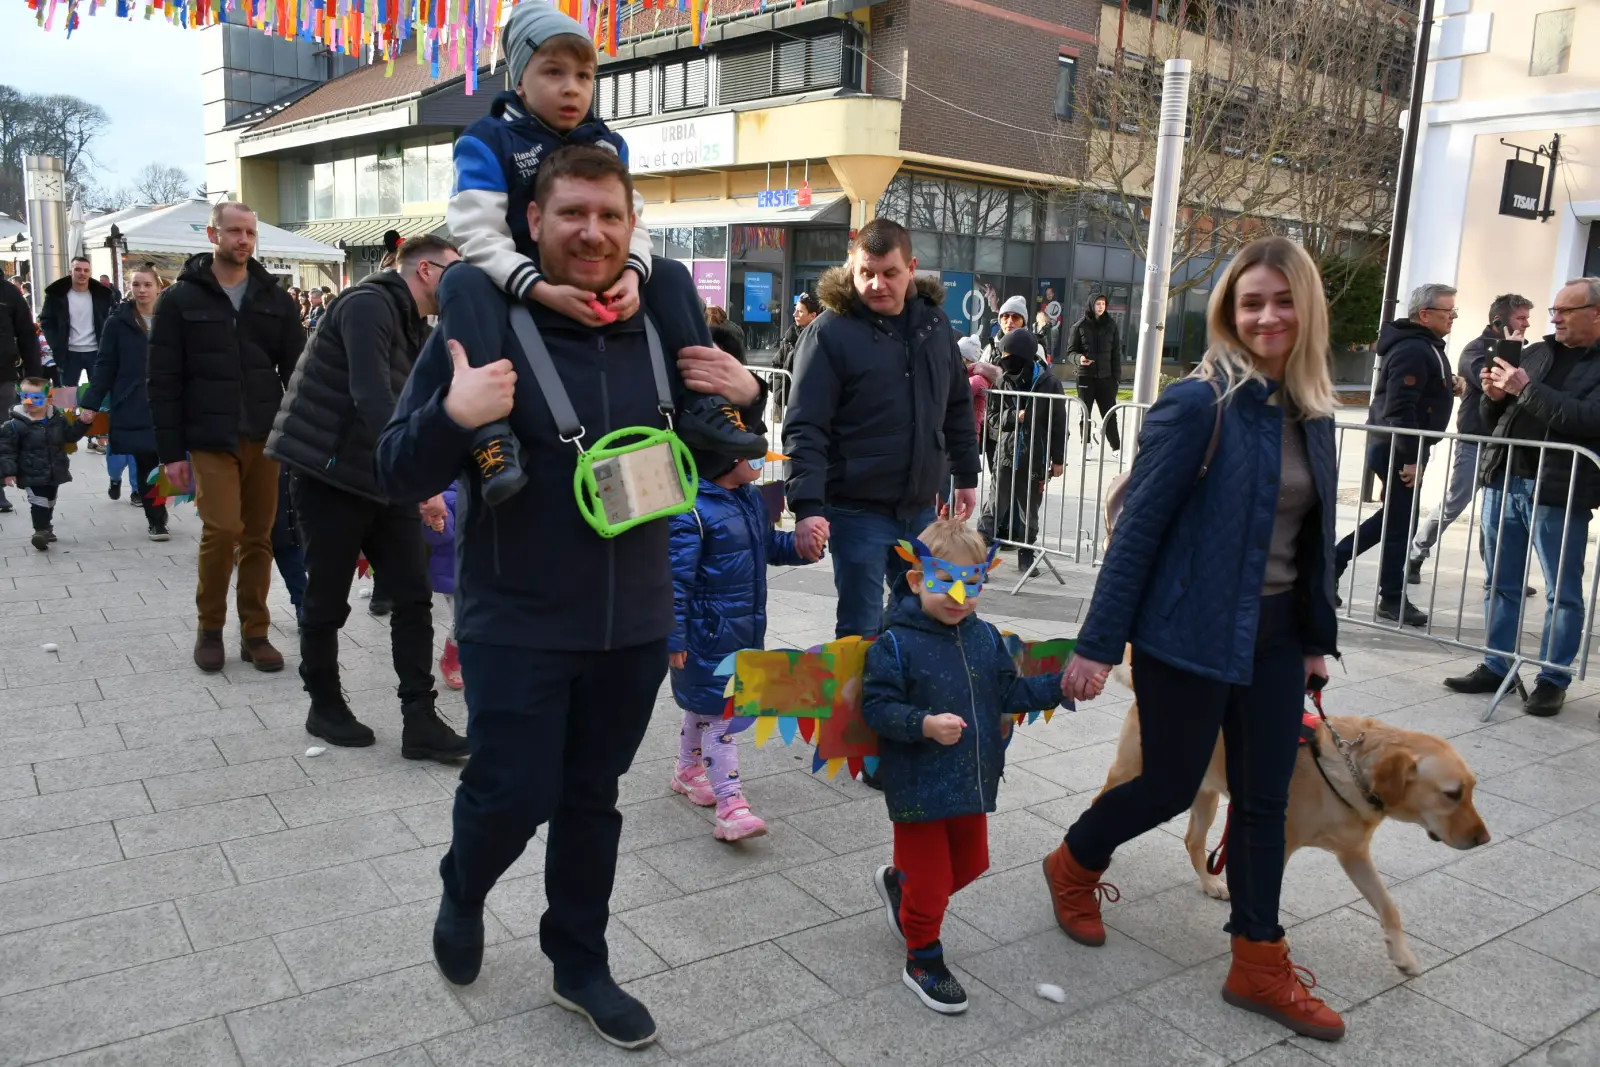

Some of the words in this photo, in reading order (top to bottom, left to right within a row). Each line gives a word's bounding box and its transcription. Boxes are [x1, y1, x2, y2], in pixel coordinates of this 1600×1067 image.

[661, 123, 696, 142] URBIA
[516, 157, 540, 169] With
[654, 150, 667, 166] et
[703, 143, 720, 161] 25
[519, 168, 537, 178] The
[757, 189, 797, 208] ERSTE
[1512, 193, 1537, 211] TISAK
